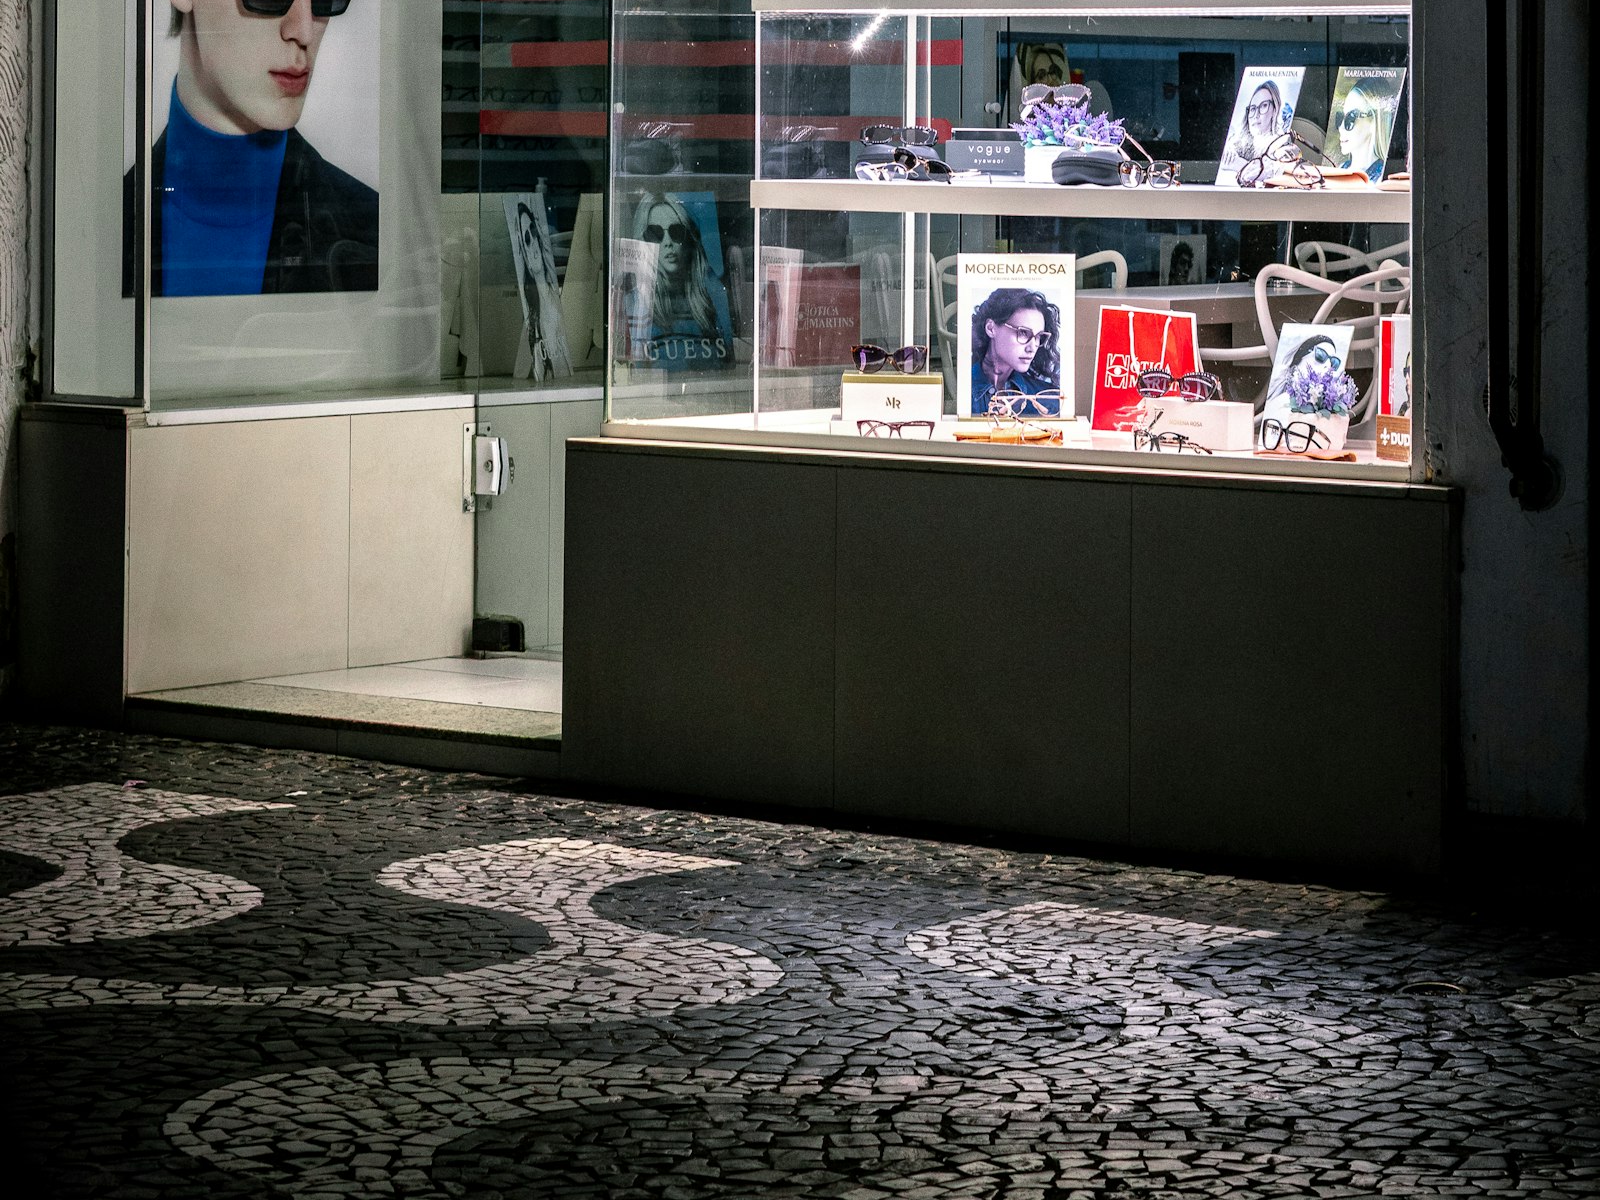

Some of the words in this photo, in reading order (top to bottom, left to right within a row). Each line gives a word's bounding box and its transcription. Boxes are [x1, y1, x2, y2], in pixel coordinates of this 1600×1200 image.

[968, 145, 1011, 156] vogue
[965, 263, 1025, 274] MORENA
[1029, 263, 1066, 274] ROSA
[809, 316, 855, 328] MARTINS
[644, 339, 727, 360] GUESS
